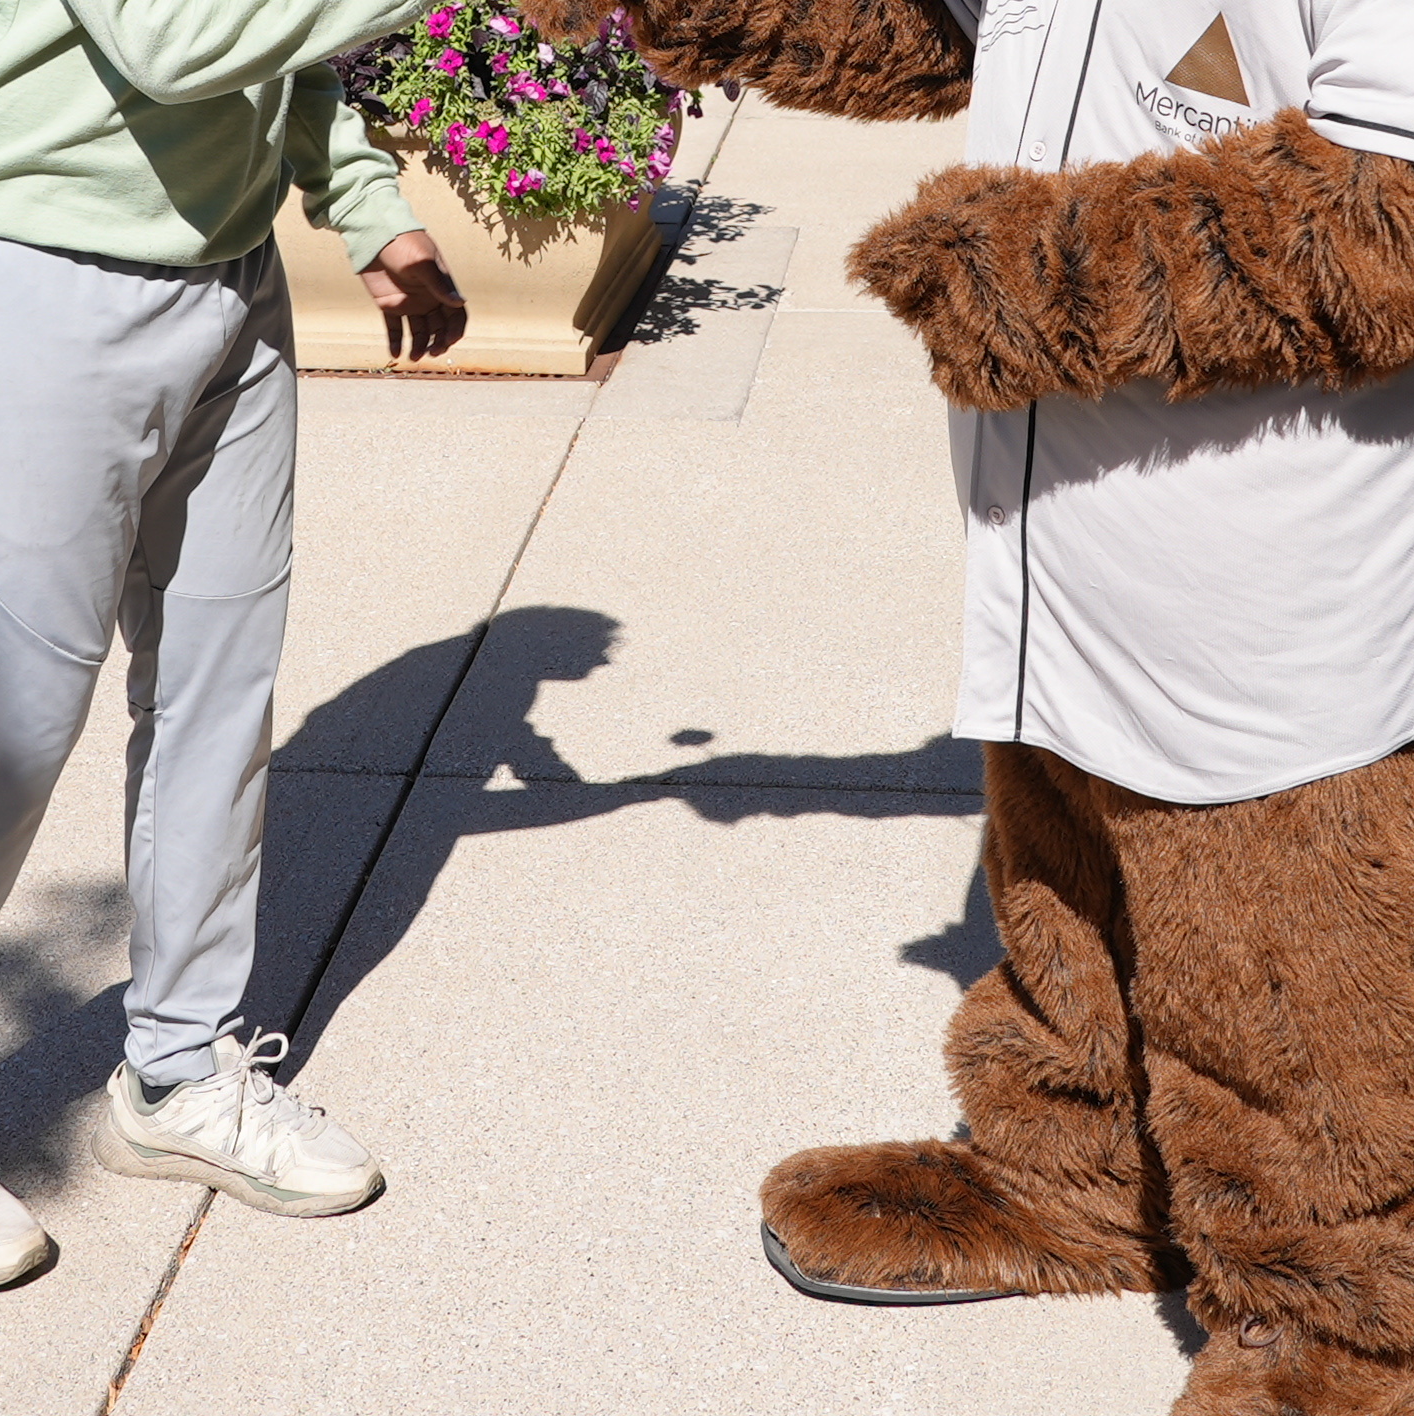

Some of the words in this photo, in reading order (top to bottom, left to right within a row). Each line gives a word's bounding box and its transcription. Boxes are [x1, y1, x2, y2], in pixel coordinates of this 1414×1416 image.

[1135, 81, 1257, 136] Mercanti
[1154, 120, 1182, 138] Bank
[1184, 133, 1197, 144] of
